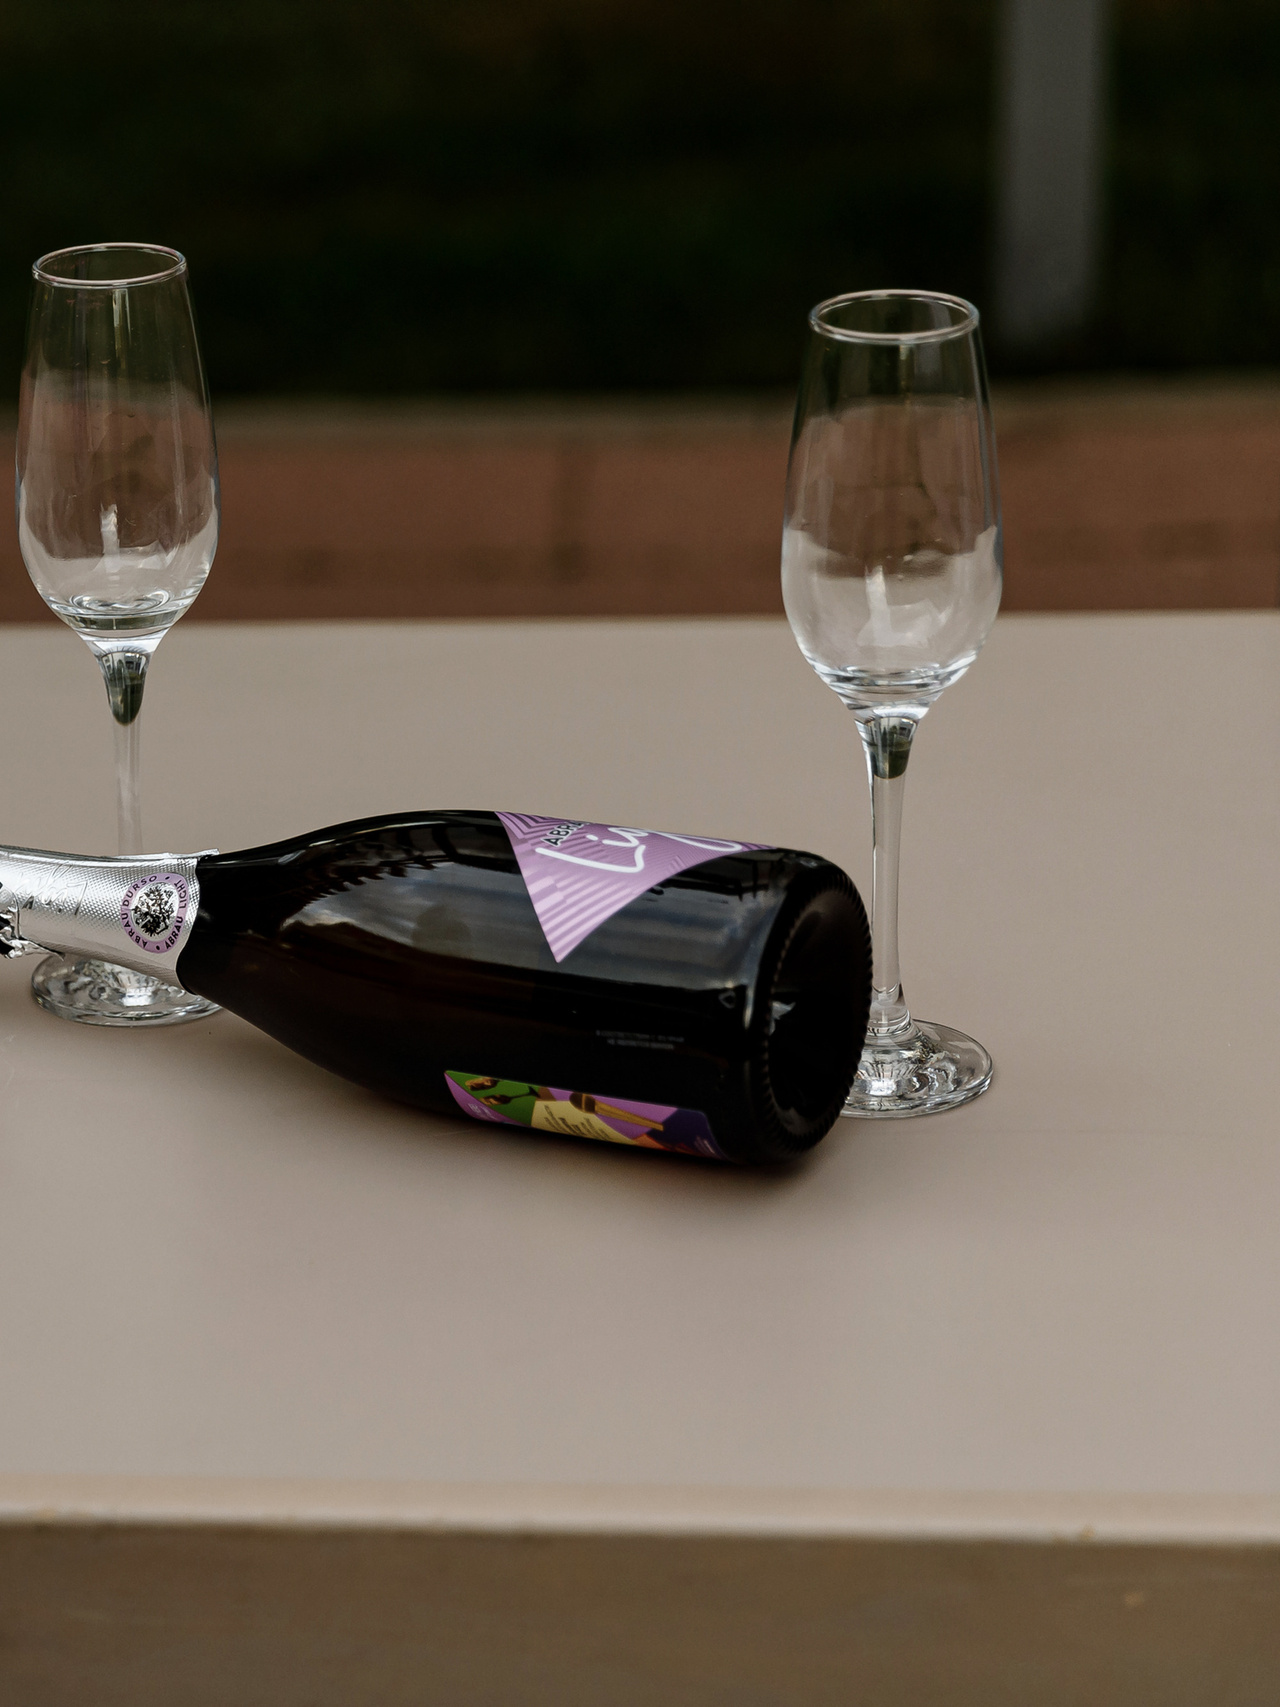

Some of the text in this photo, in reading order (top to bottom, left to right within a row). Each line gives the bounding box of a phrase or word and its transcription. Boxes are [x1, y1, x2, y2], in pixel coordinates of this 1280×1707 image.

[121, 875, 158, 948] ABRAU DURSO
[164, 880, 187, 950] ABRAU LIGHT
